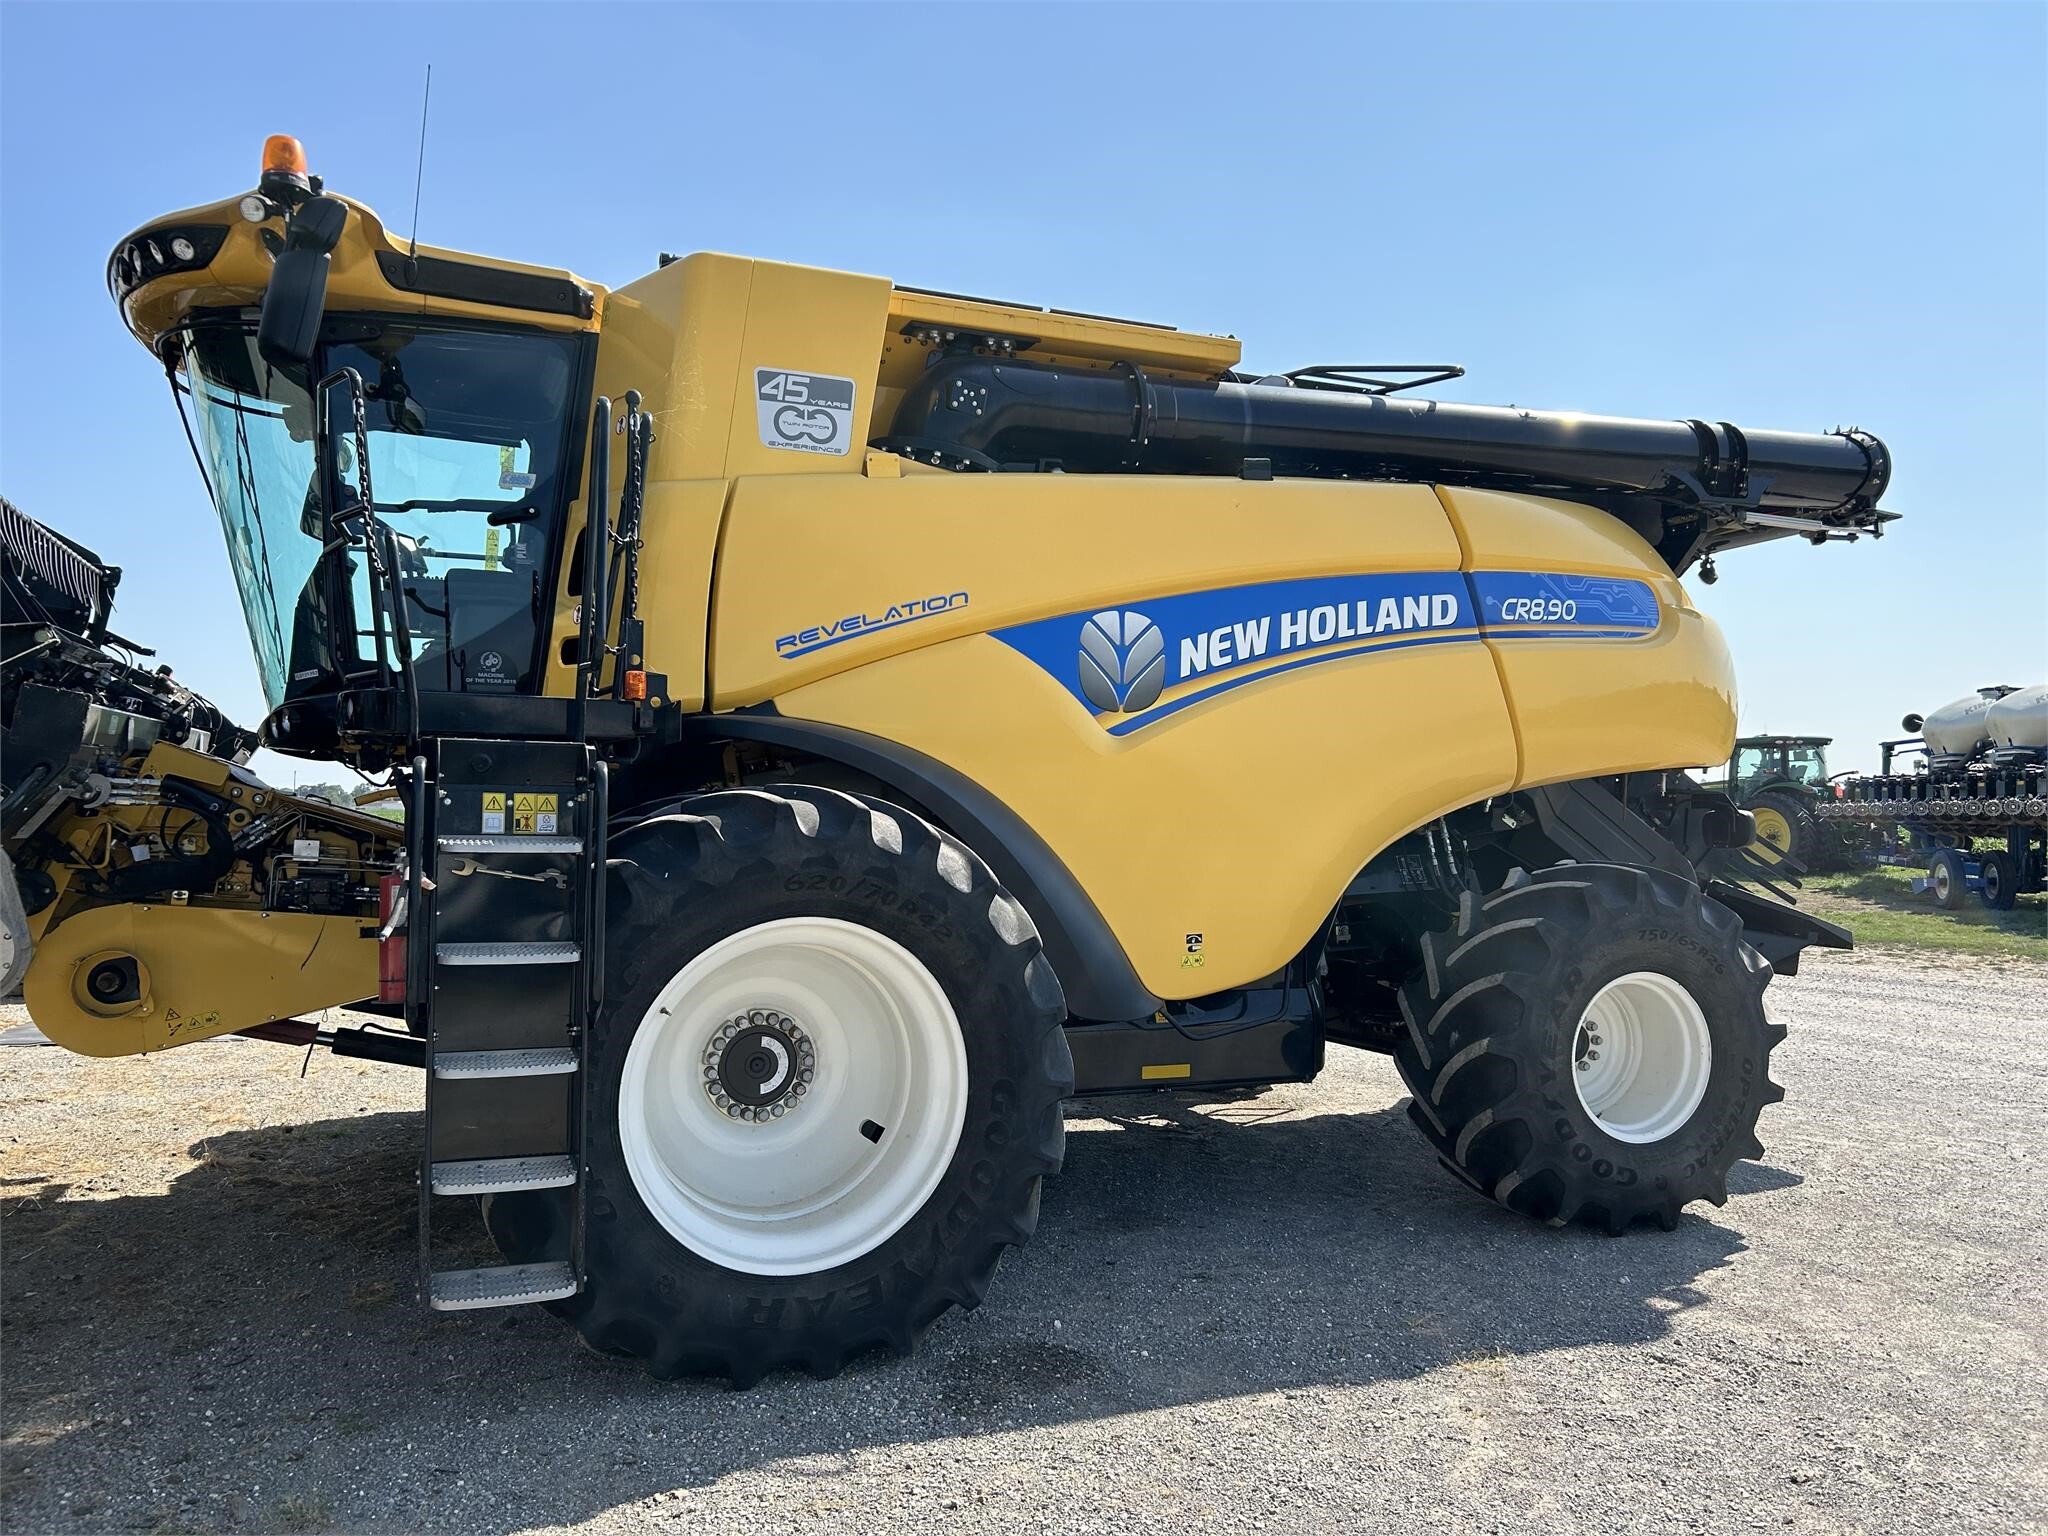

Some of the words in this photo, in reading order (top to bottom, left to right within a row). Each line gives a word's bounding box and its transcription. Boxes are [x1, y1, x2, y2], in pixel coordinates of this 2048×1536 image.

[761, 374, 811, 403] 45
[810, 398, 849, 409] YEARS
[802, 422, 830, 431] ROTOR
[767, 440, 842, 454] EXPERIENCE
[775, 591, 969, 652] REVELATION
[1501, 598, 1577, 621] CR8.90
[1180, 616, 1271, 678] NEW
[1280, 594, 1459, 650] HOLLAND
[784, 873, 953, 943] 620/70R42
[1637, 929, 1727, 975] 750/65R26
